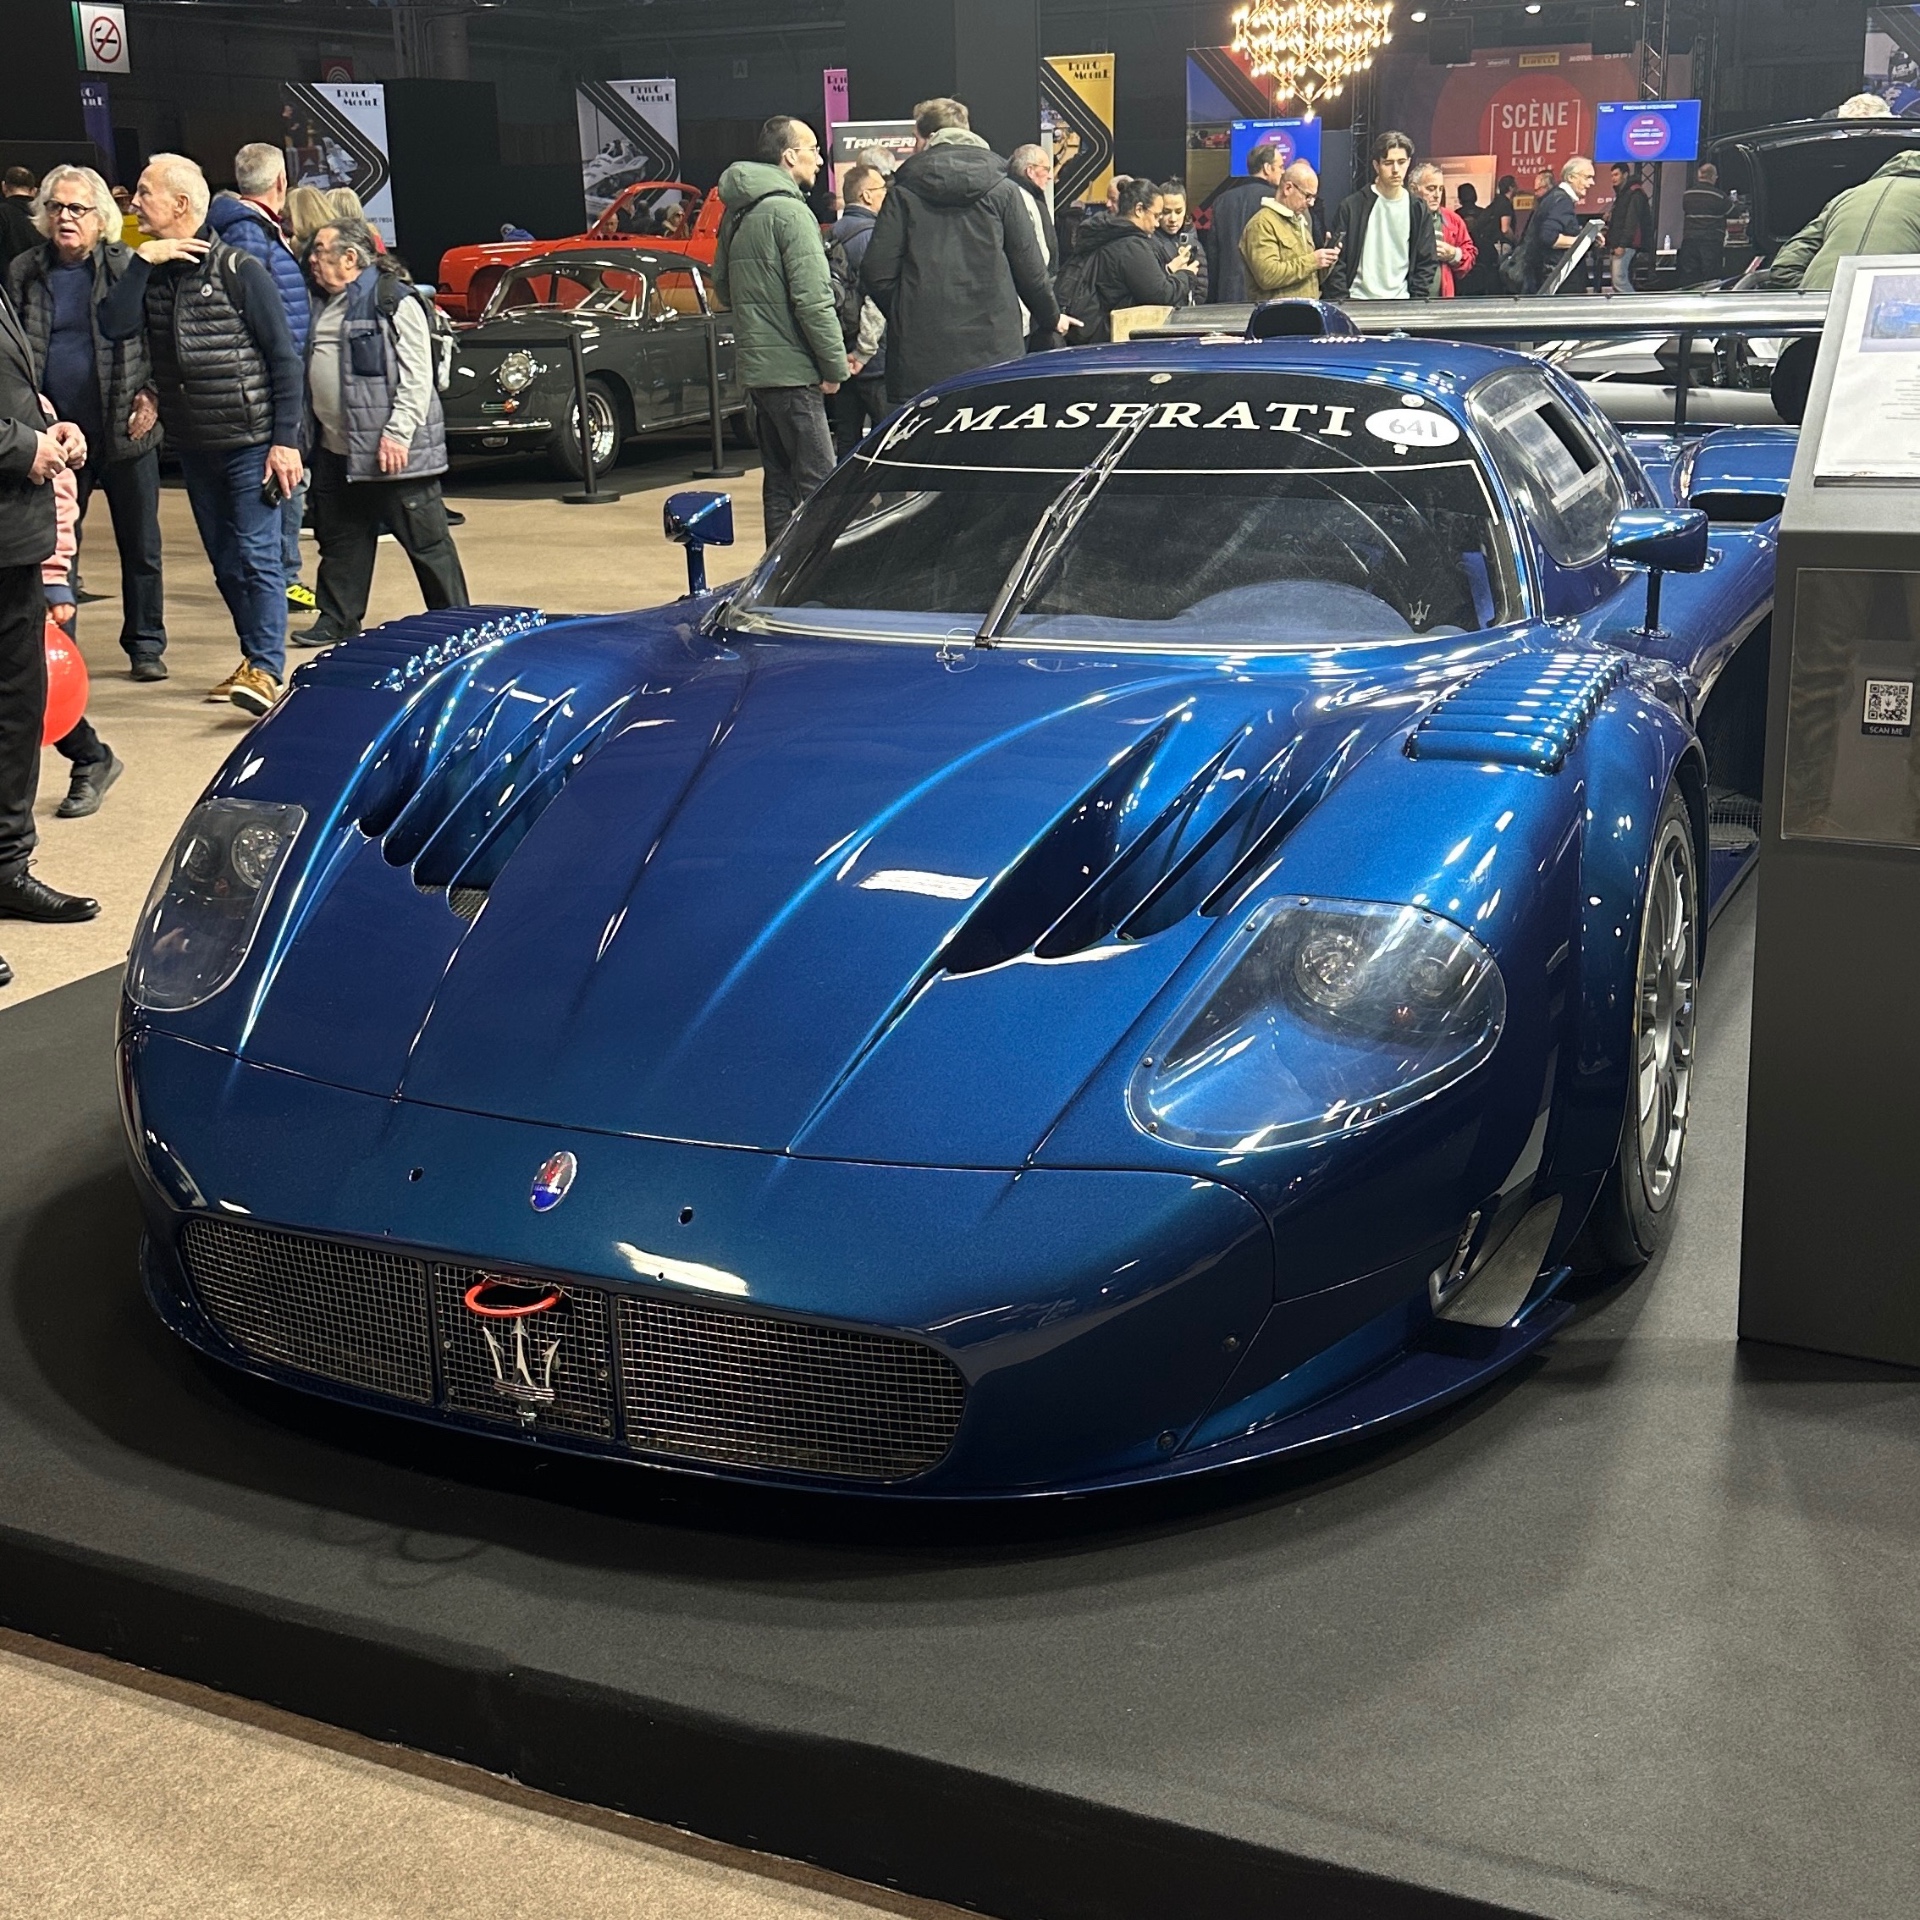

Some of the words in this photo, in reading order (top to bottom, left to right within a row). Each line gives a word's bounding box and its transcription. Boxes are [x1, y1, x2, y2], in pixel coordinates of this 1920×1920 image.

[1502, 98, 1569, 129] SCÈNE
[1512, 129, 1557, 155] LIVE
[935, 401, 1356, 437] MASERATI
[1388, 418, 1438, 438] 641
[1869, 725, 1890, 735] SCAN
[1891, 727, 1904, 736] ME
